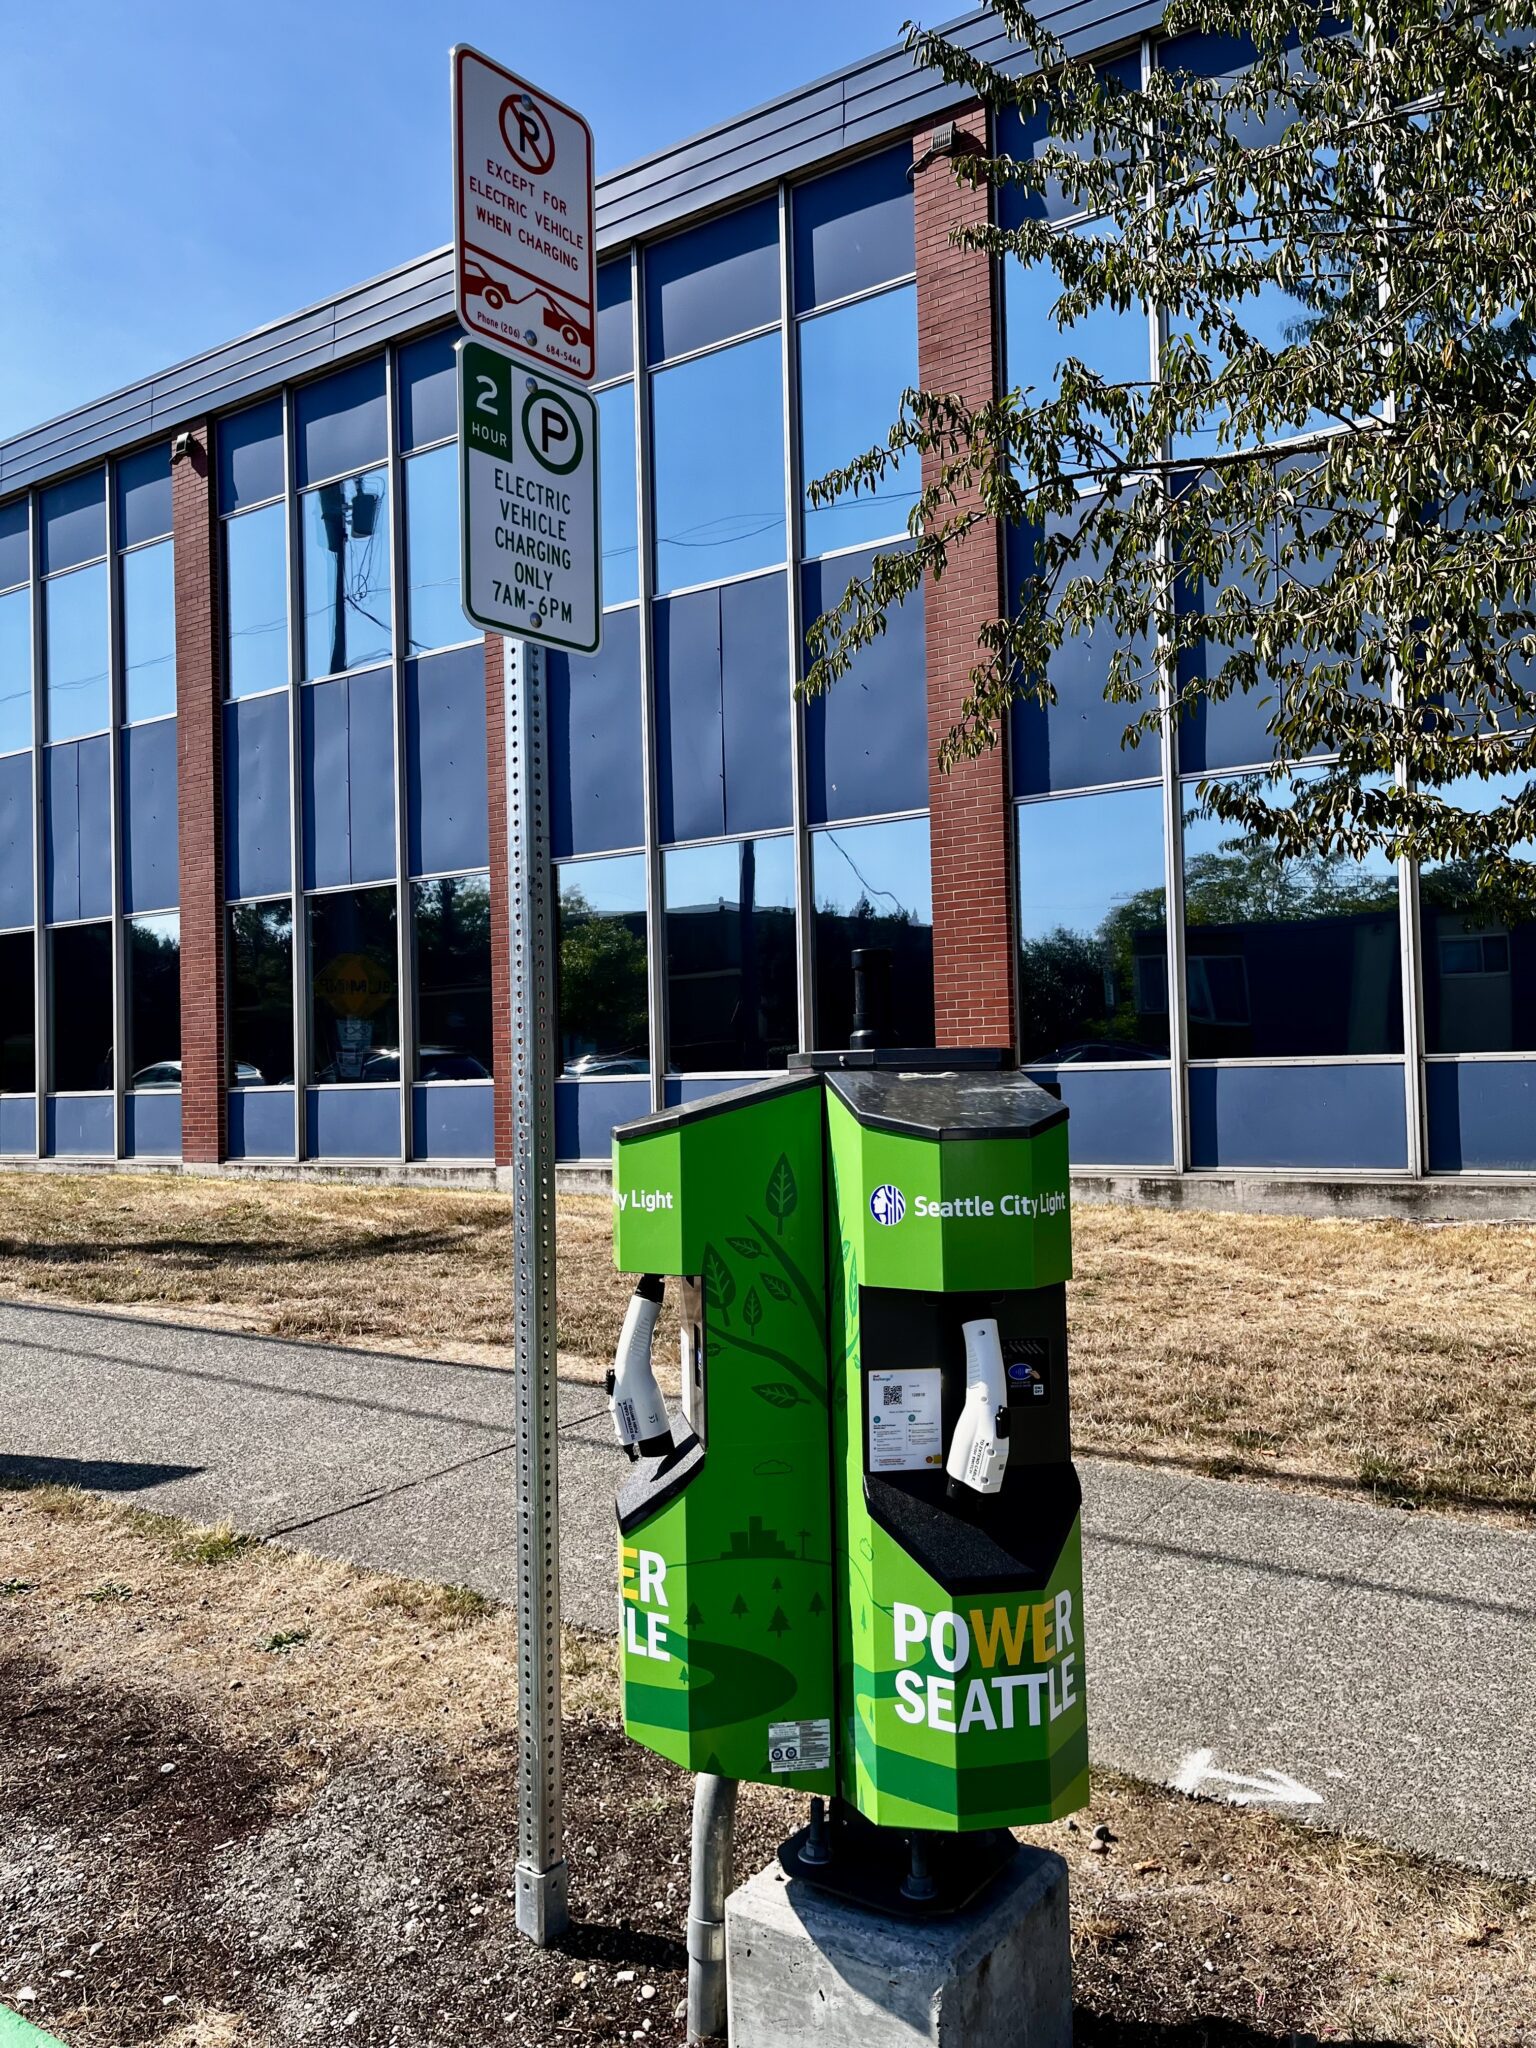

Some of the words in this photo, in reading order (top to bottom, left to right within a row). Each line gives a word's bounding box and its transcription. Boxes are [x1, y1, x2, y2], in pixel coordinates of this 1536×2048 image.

[486, 158, 535, 197] EXCEPT
[543, 190, 567, 216] FOR
[469, 175, 528, 219] ELECTRIC
[534, 211, 584, 250] VEHICLE
[476, 205, 512, 237] WHEN
[518, 228, 579, 272] CHARGING
[476, 311, 499, 330] Phone
[500, 322, 521, 339] (206)
[546, 344, 581, 367] 684-5444
[475, 374, 499, 417] 2
[471, 421, 507, 448] HOUR
[541, 406, 569, 454] P
[494, 467, 571, 516] ELECTRIC
[499, 498, 567, 542] VEHICLE
[494, 526, 571, 570] CHARGING
[514, 561, 553, 592] ONLY
[631, 1189, 674, 1213] Light
[914, 1195, 995, 1218] Seattle
[999, 1194, 1038, 1219] City
[1039, 1190, 1066, 1216] Light
[893, 1589, 1075, 1673] POWER
[893, 1652, 1077, 1734] SEATTLE
